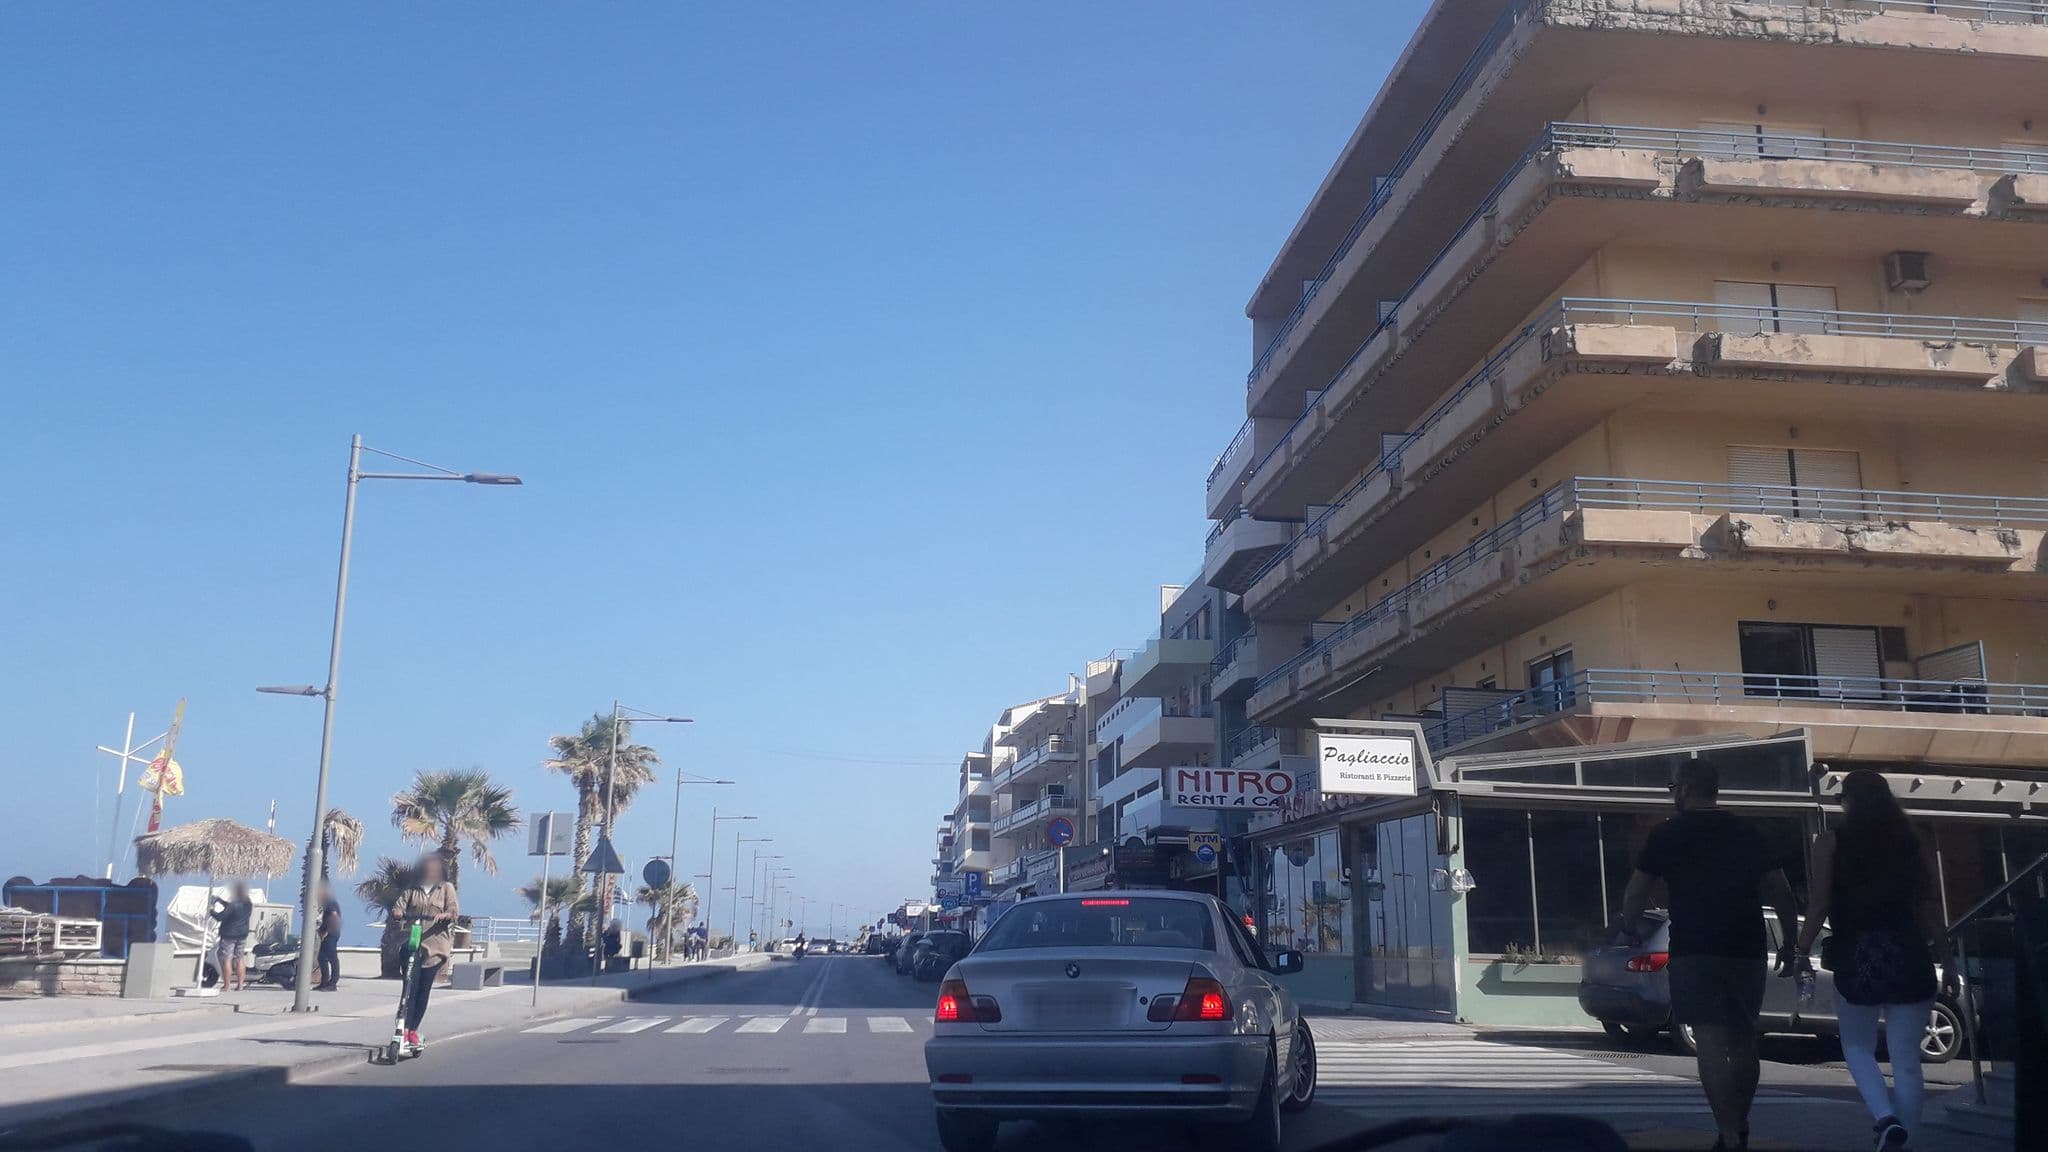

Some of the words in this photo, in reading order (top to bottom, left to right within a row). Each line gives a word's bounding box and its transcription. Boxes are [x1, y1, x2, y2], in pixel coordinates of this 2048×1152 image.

[1323, 746, 1410, 767] Pagliaccio
[1177, 769, 1293, 795] NITRO
[1339, 771, 1375, 780] Ristoranti
[1376, 773, 1382, 781] E
[1177, 794, 1227, 805] RENT
[1233, 796, 1245, 806] A
[1252, 796, 1284, 807] CA
[1194, 834, 1218, 843] ATM
[968, 873, 977, 887] P
